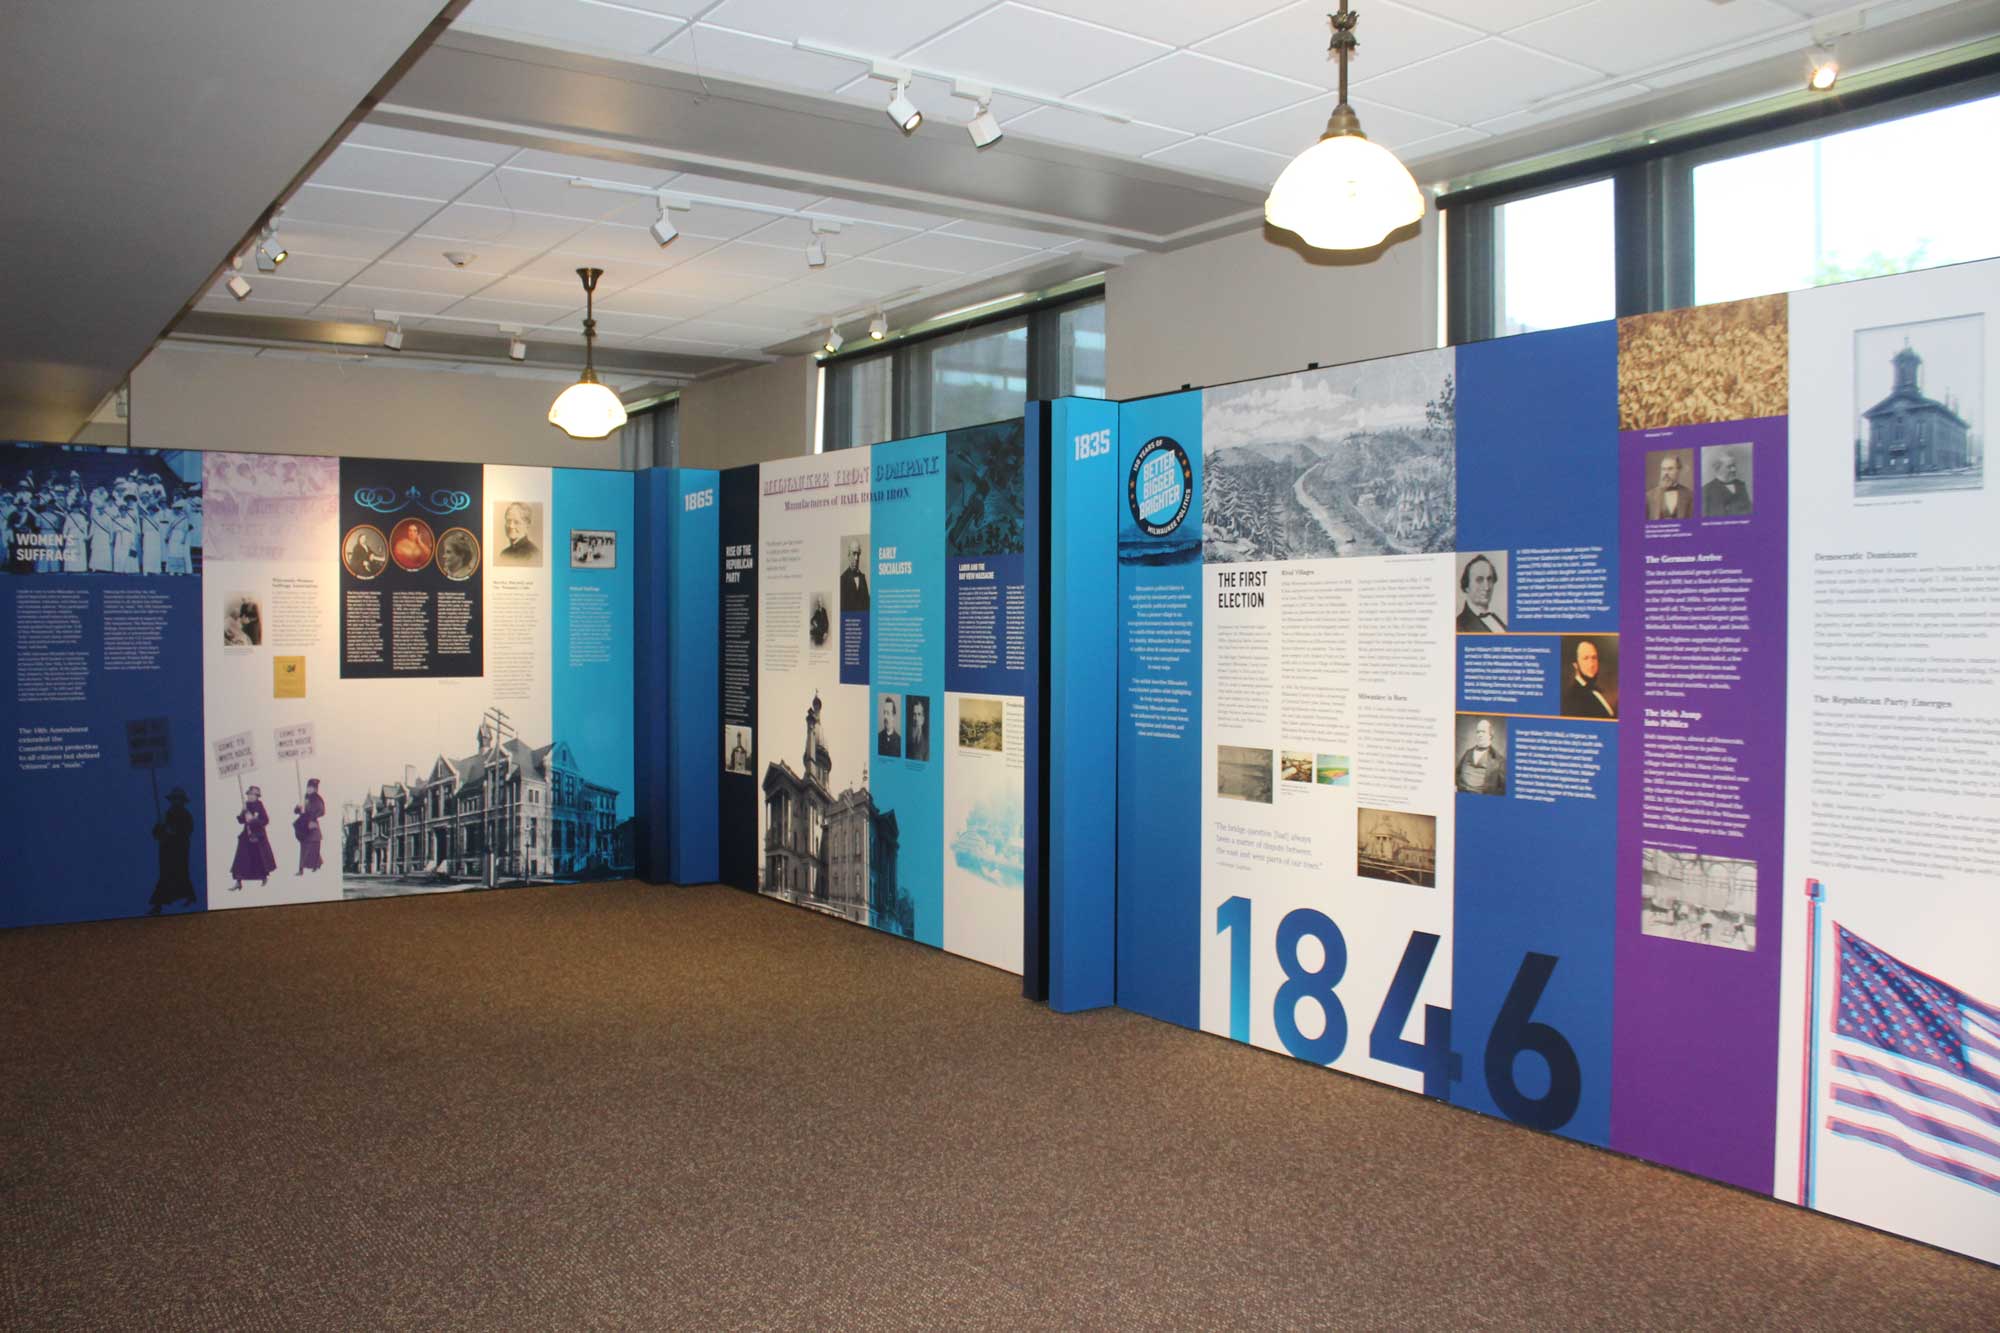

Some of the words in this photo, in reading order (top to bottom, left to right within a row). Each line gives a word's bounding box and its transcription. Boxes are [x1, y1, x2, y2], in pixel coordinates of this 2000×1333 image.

[1074, 428, 1110, 462] 1835
[1139, 442, 1155, 460] YEARS
[1144, 449, 1176, 482] BETTER
[1144, 468, 1176, 502] BIGGER
[685, 489, 713, 512] 1865
[785, 498, 830, 512] Manufacturers
[840, 494, 859, 505] RAIL
[860, 491, 884, 503] ROAD
[886, 488, 910, 502] IRON
[1140, 484, 1180, 520] BRIGHTER
[1147, 522, 1178, 536] MILWAUKEE
[1176, 488, 1191, 522] POLITICS
[16, 532, 74, 546] WOMEN'S
[16, 548, 79, 562] SUFFRAGE
[726, 546, 736, 556] RISE
[736, 545, 741, 556] OF
[742, 544, 751, 556] THE
[879, 546, 896, 560] EARLY
[1814, 552, 1864, 561] Democratic
[726, 557, 753, 570] REPUBLICAN
[1645, 556, 1660, 564] The
[879, 562, 912, 576] SOCIALISTS
[726, 572, 740, 583] PARTY
[1218, 572, 1236, 588] THE
[1239, 570, 1268, 588] FIRST
[1218, 592, 1264, 608] ELECTION
[1813, 695, 1829, 703] The
[1832, 696, 1881, 706] Republican
[1883, 697, 1908, 708] Party
[1912, 698, 1952, 709] Emerges
[1645, 710, 1659, 718] The
[1217, 895, 1582, 1132] 1846
